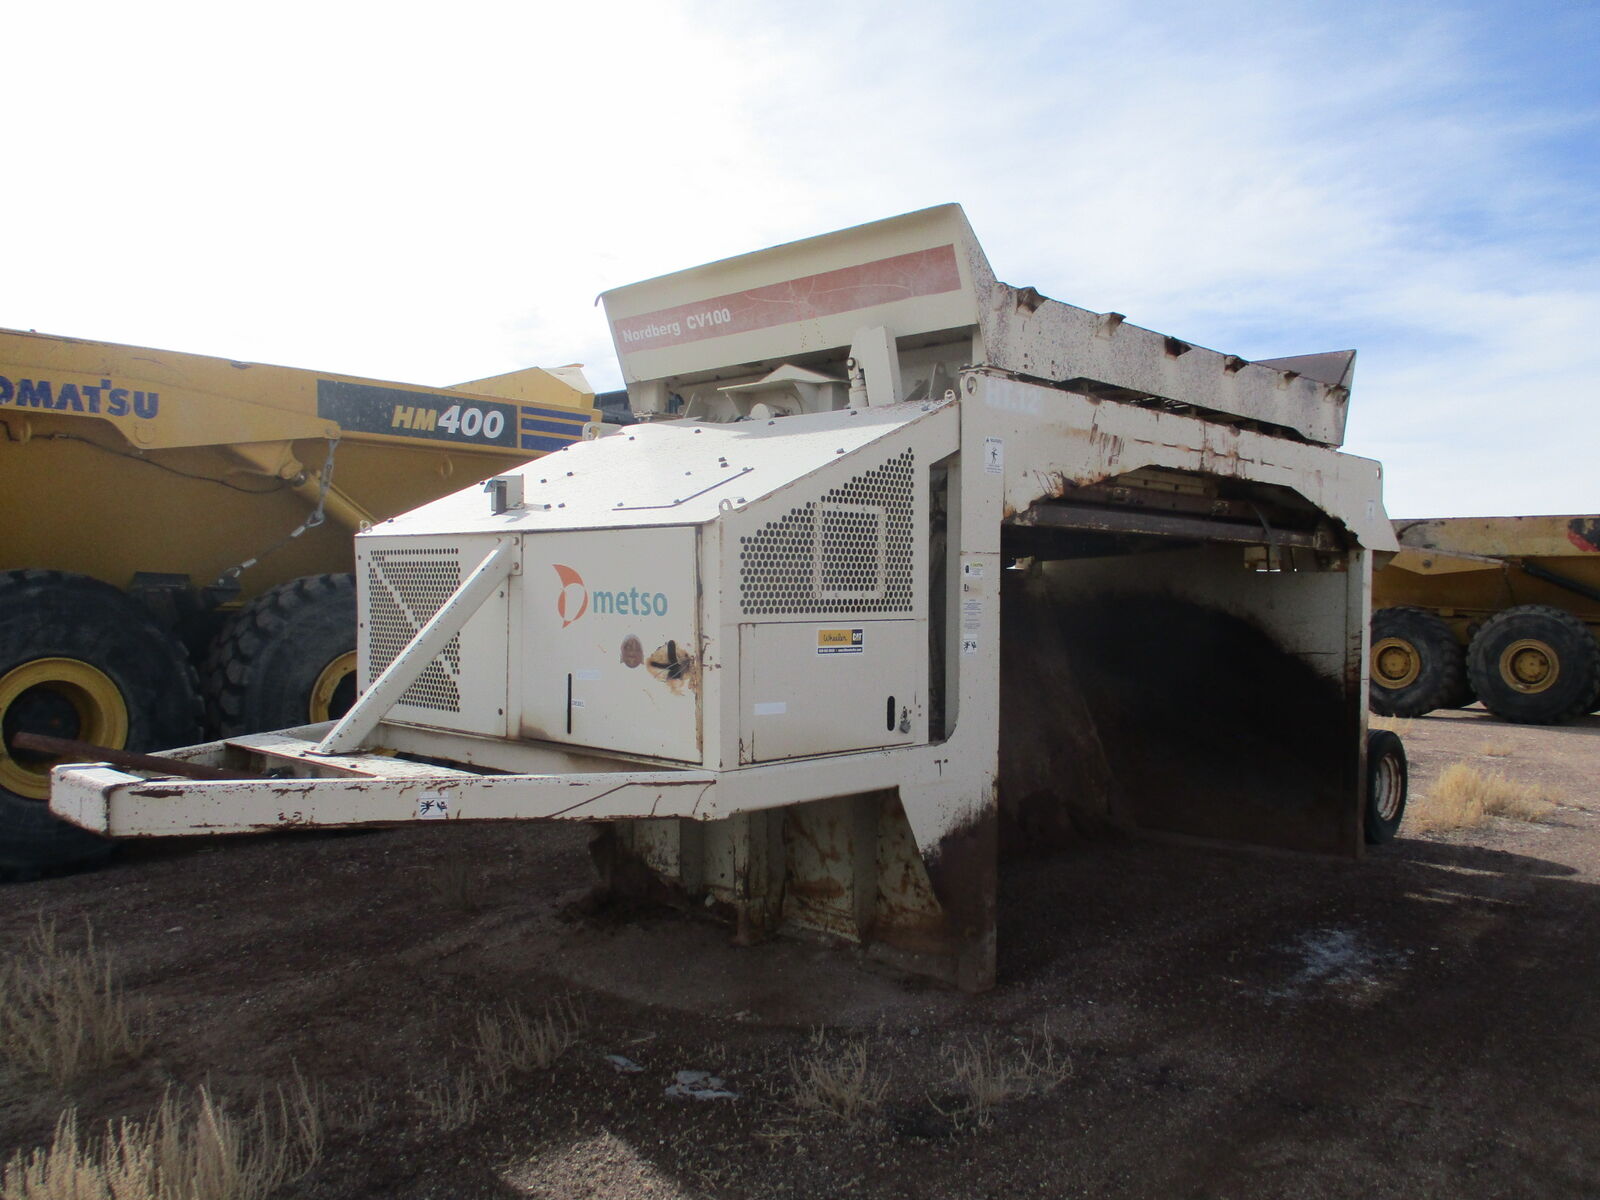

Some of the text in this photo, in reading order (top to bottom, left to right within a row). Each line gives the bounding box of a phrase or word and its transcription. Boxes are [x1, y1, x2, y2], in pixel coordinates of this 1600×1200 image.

[622, 308, 731, 343] Nordberg CV100
[391, 405, 505, 439] HM400
[593, 587, 668, 617] metso
